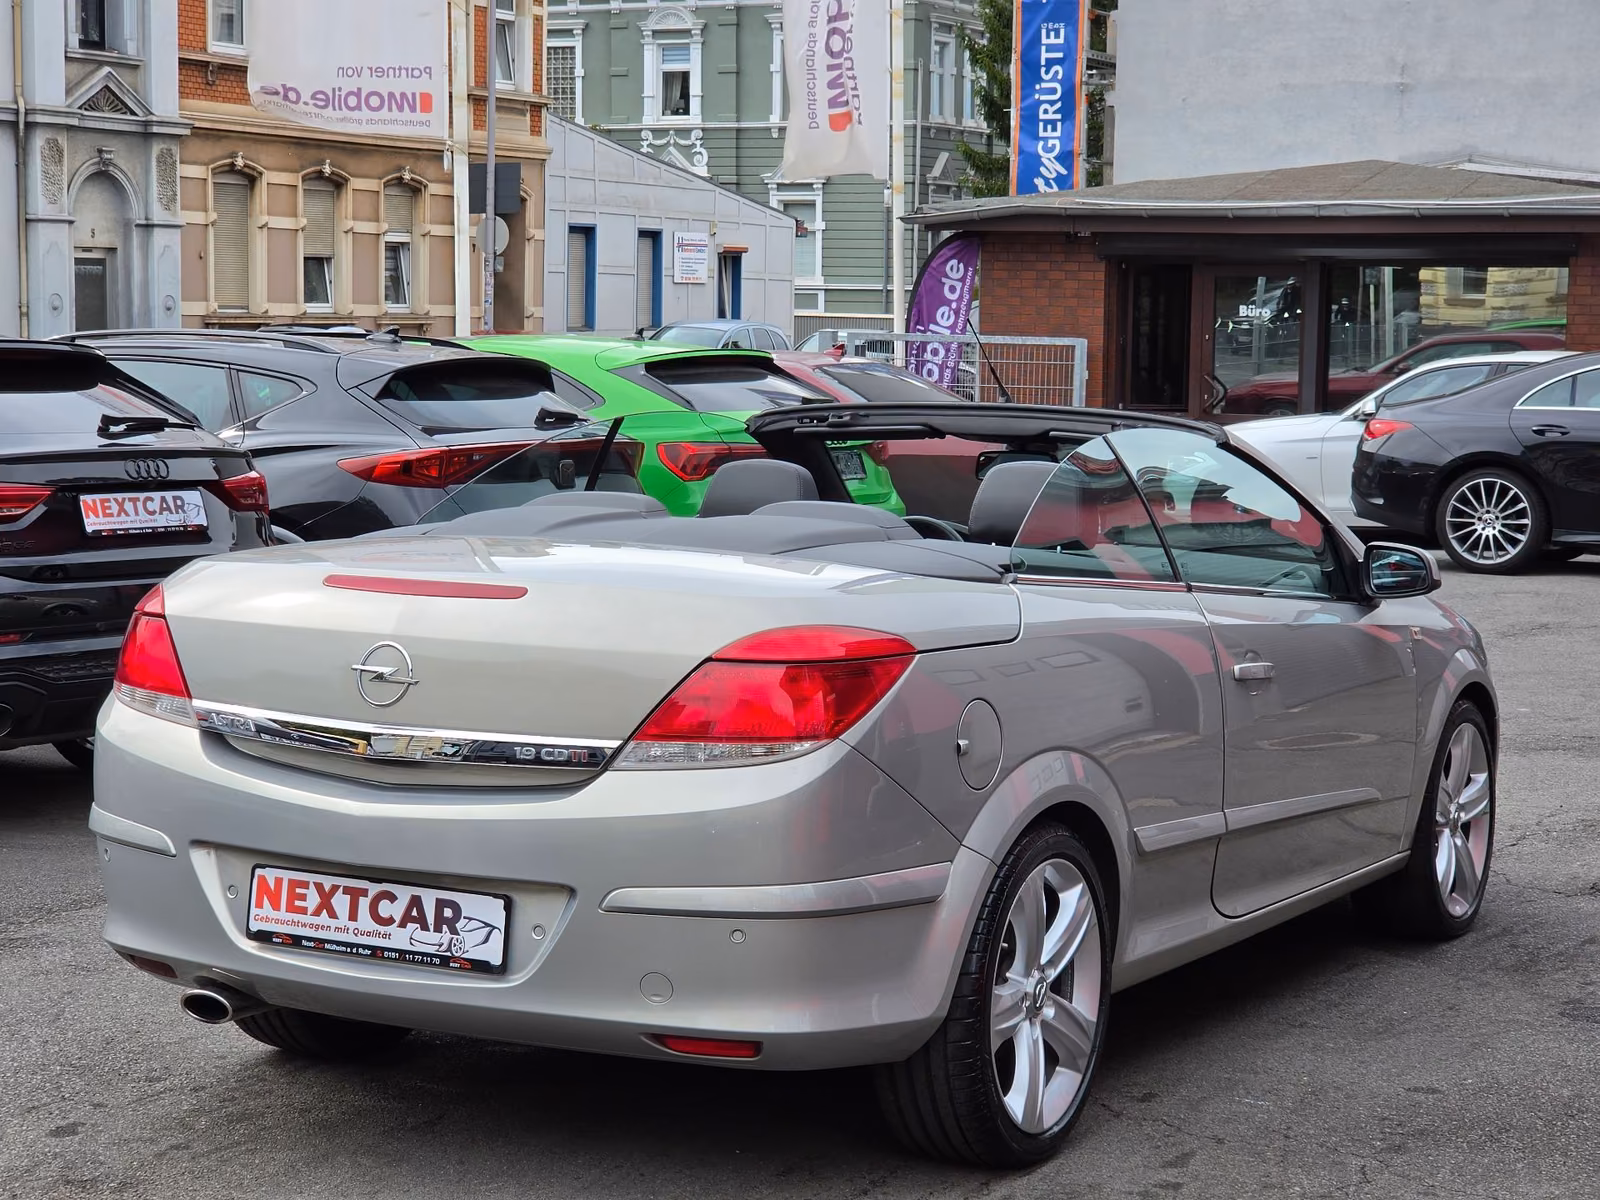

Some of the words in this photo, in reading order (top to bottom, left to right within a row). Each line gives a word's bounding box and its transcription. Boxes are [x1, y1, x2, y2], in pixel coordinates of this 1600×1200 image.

[90, 227, 96, 239] 5
[922, 258, 965, 383] oble.de
[1238, 304, 1271, 317] Büro
[81, 495, 188, 519] NEXTCAR
[207, 712, 257, 732] ASTRA
[540, 748, 588, 763] CDTI
[254, 873, 463, 937] NEXTCAR
[253, 913, 332, 932] Gebrauchtwagen
[333, 925, 350, 935] mit
[352, 926, 392, 941] Qualität
[383, 951, 399, 959] 0151
